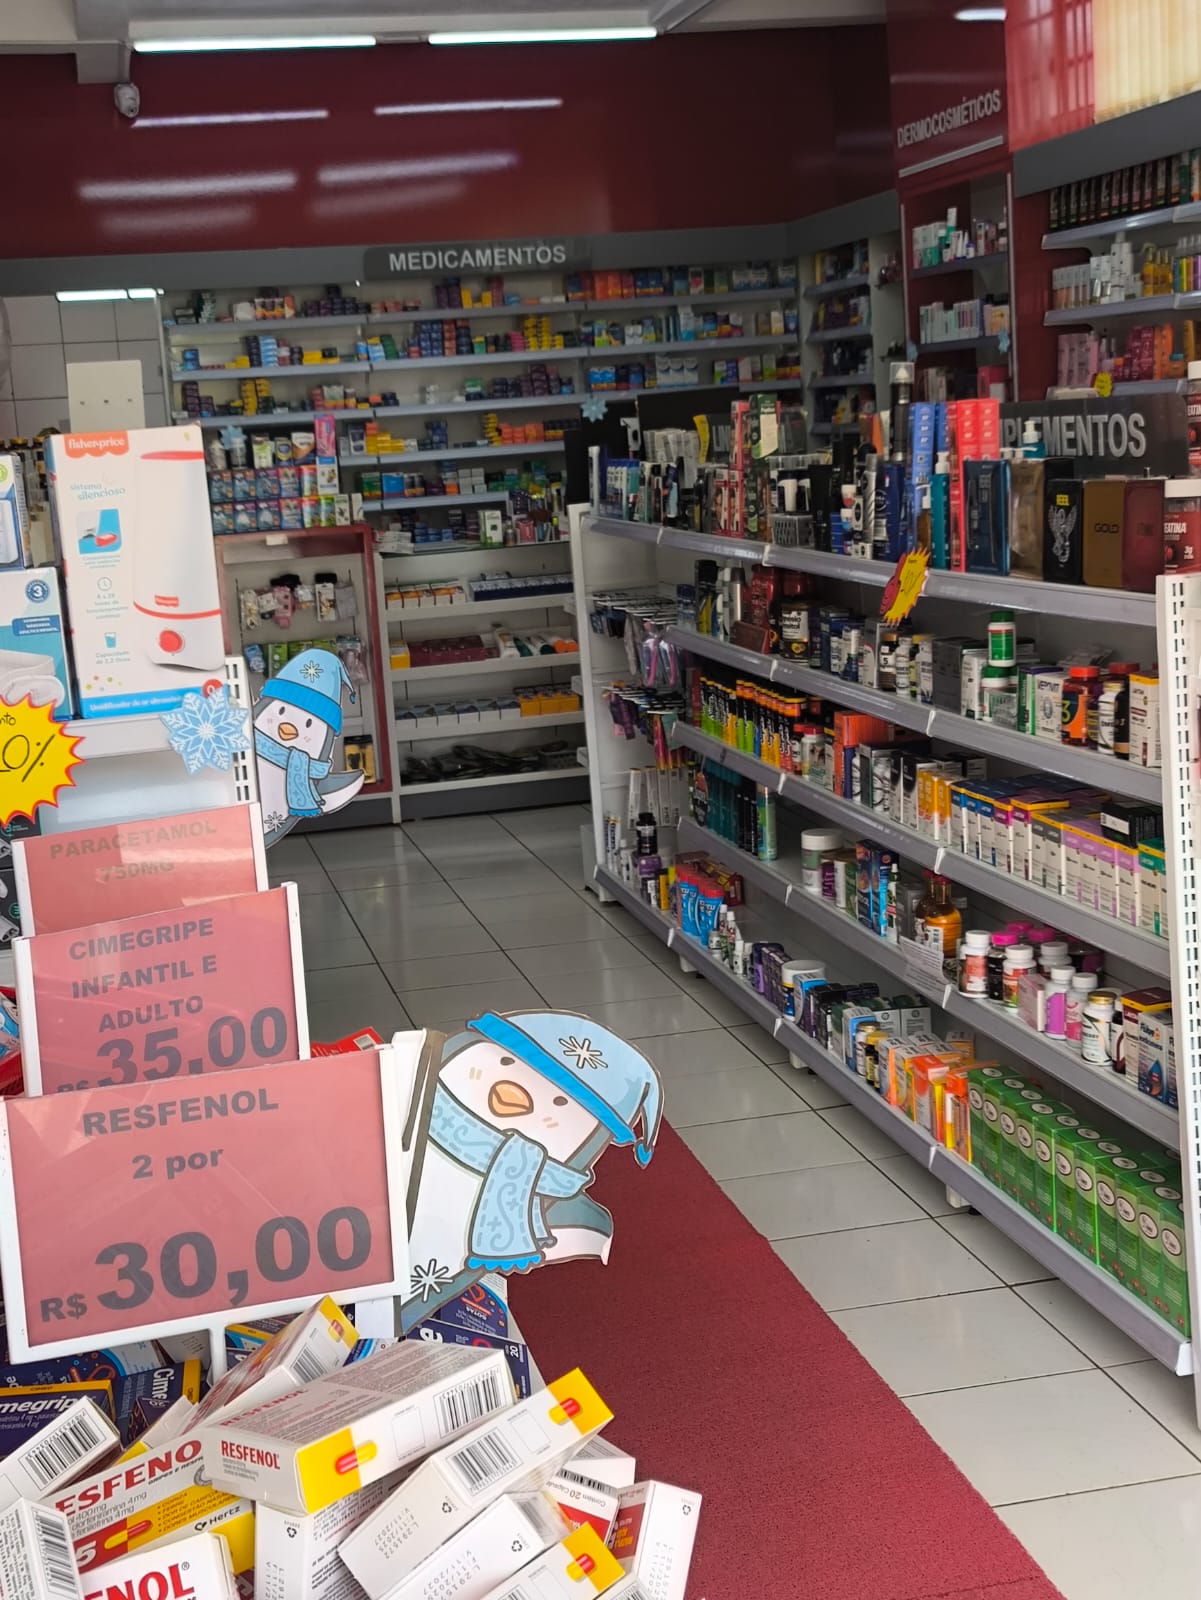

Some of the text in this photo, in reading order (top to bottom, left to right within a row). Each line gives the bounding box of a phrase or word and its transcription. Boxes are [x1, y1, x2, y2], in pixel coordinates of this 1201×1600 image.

[897, 89, 1001, 148] DERMOCOSMÉTICOS
[388, 245, 566, 272] MEDICAMENTOS
[1000, 412, 1147, 458] PLMENTOS
[78, 486, 126, 501] silencioso
[1094, 523, 1119, 533] GOLD
[33, 585, 43, 597] 3
[50, 819, 217, 860] PARACETAMOL
[101, 861, 174, 882] 750MG
[69, 918, 214, 961] CIMEGRIPE
[72, 955, 217, 999] INFANTIL E
[98, 995, 204, 1033] ADULTO
[82, 1088, 279, 1137] RESFENOL
[132, 1149, 224, 1179] 2 por
[40, 1206, 372, 1323] R$ 30,00
[509, 1345, 519, 1358] 20
[221, 1440, 281, 1470] RESFENOL
[570, 1489, 581, 1499] 20
[209, 1506, 241, 1525] Hertz
